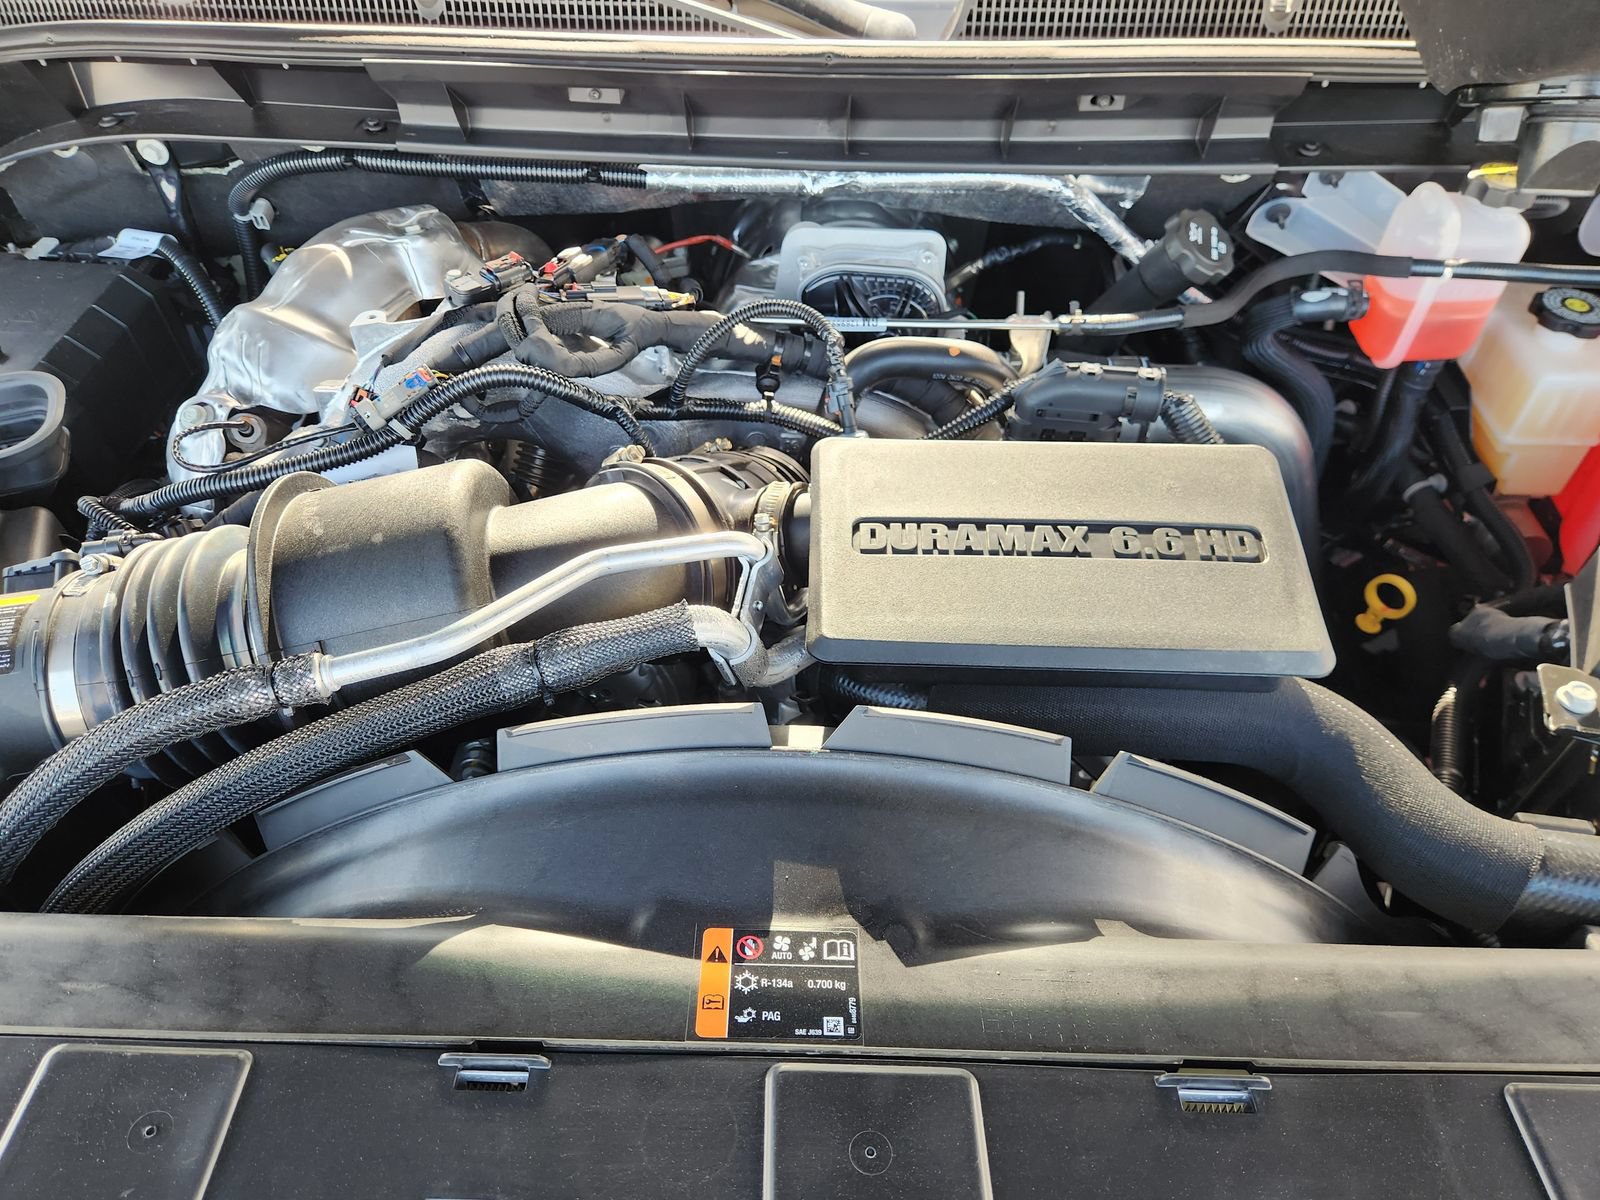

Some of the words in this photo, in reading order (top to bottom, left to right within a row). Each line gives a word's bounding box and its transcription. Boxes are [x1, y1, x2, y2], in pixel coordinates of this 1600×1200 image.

[859, 522, 1092, 556] DURAMAX
[1109, 526, 1185, 558] 6.6
[1193, 528, 1261, 561] HD
[771, 952, 793, 960] AUTO
[760, 979, 793, 989] R-134a
[807, 980, 833, 989] 0.700
[834, 980, 846, 991] kg
[762, 1011, 781, 1021] PAG
[794, 1028, 807, 1036] SAE
